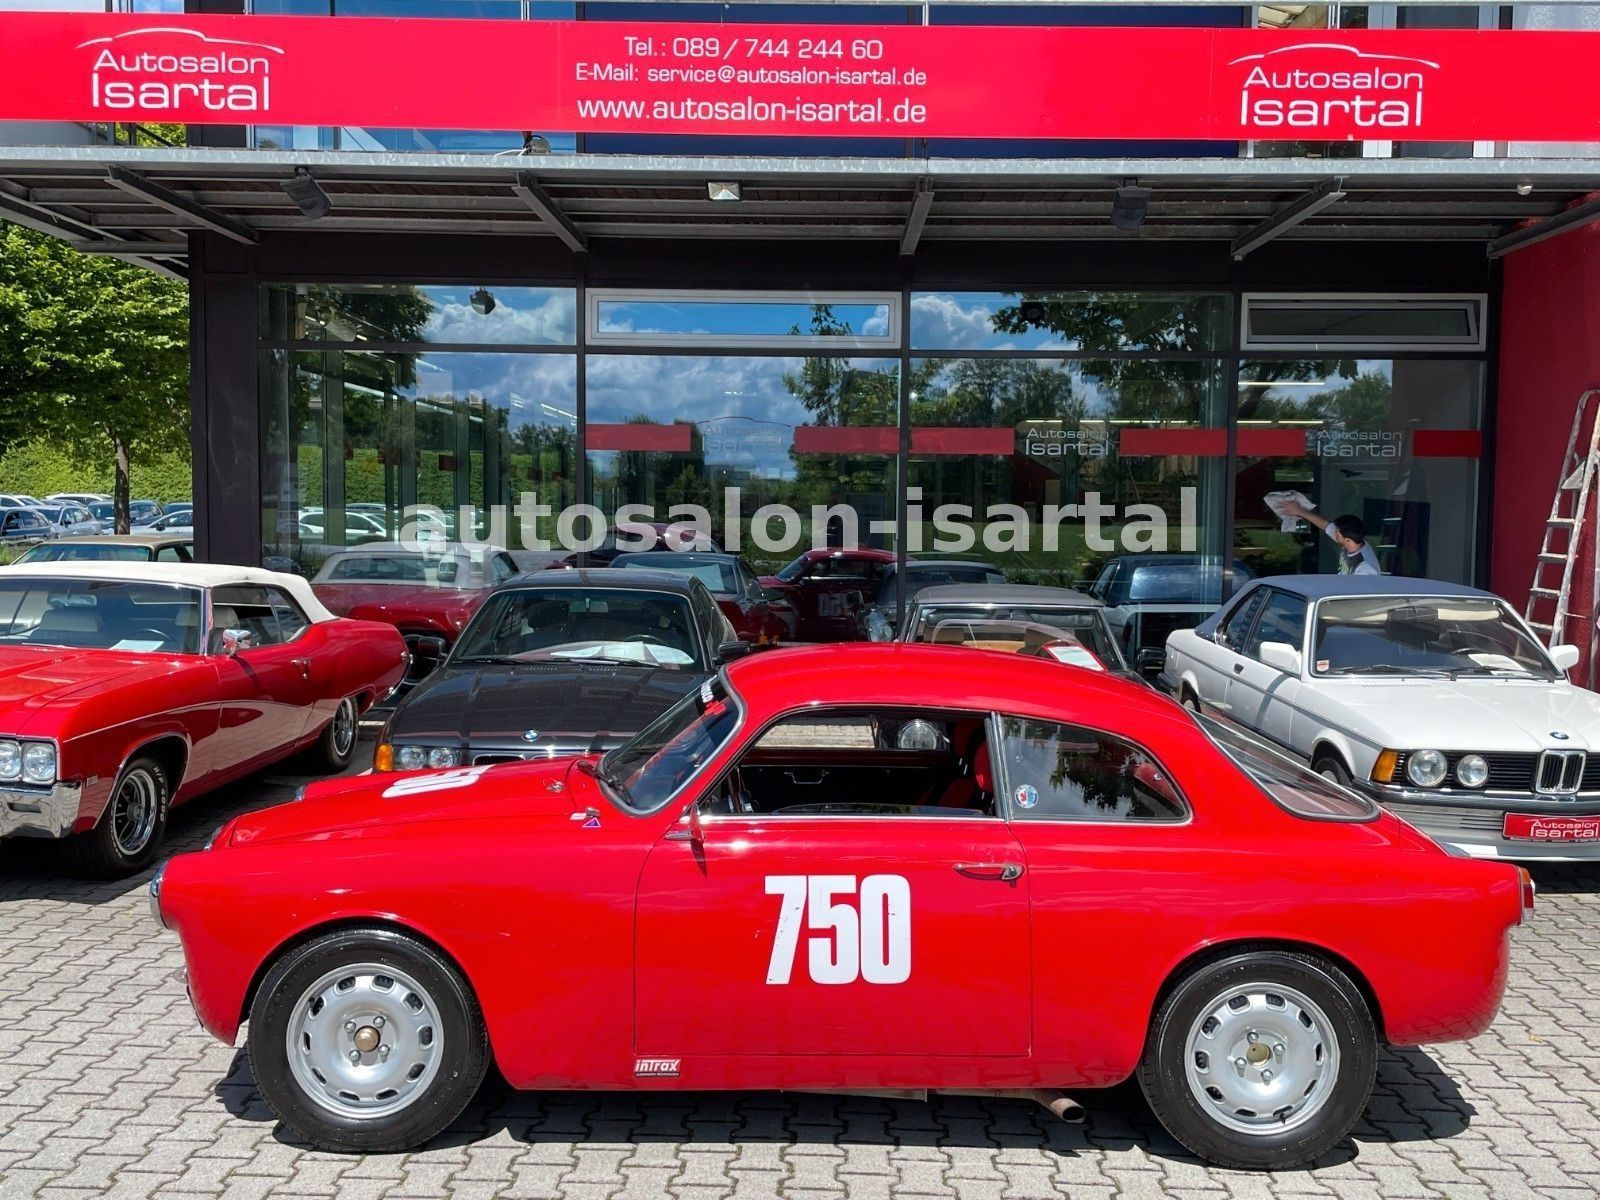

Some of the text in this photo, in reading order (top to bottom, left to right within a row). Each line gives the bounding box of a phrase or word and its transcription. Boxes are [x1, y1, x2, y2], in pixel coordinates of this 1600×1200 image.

[624, 36, 666, 57] Tel.:
[798, 38, 844, 59] 244
[851, 39, 883, 60] 60
[93, 48, 269, 74] Autosalon
[575, 62, 927, 86] E-Mail: service@autosalon-isartal.de
[1243, 66, 1423, 90] Autosalon
[92, 72, 270, 111] Isartal
[577, 95, 927, 123] www.autosalon-isartal.de
[1240, 89, 1423, 127] Isartal
[1026, 427, 1109, 439] Autosalon
[1025, 438, 1109, 456] Isartal
[1317, 440, 1402, 457] Isartal
[1530, 825, 1598, 838] Isartal
[765, 874, 911, 985] 750
